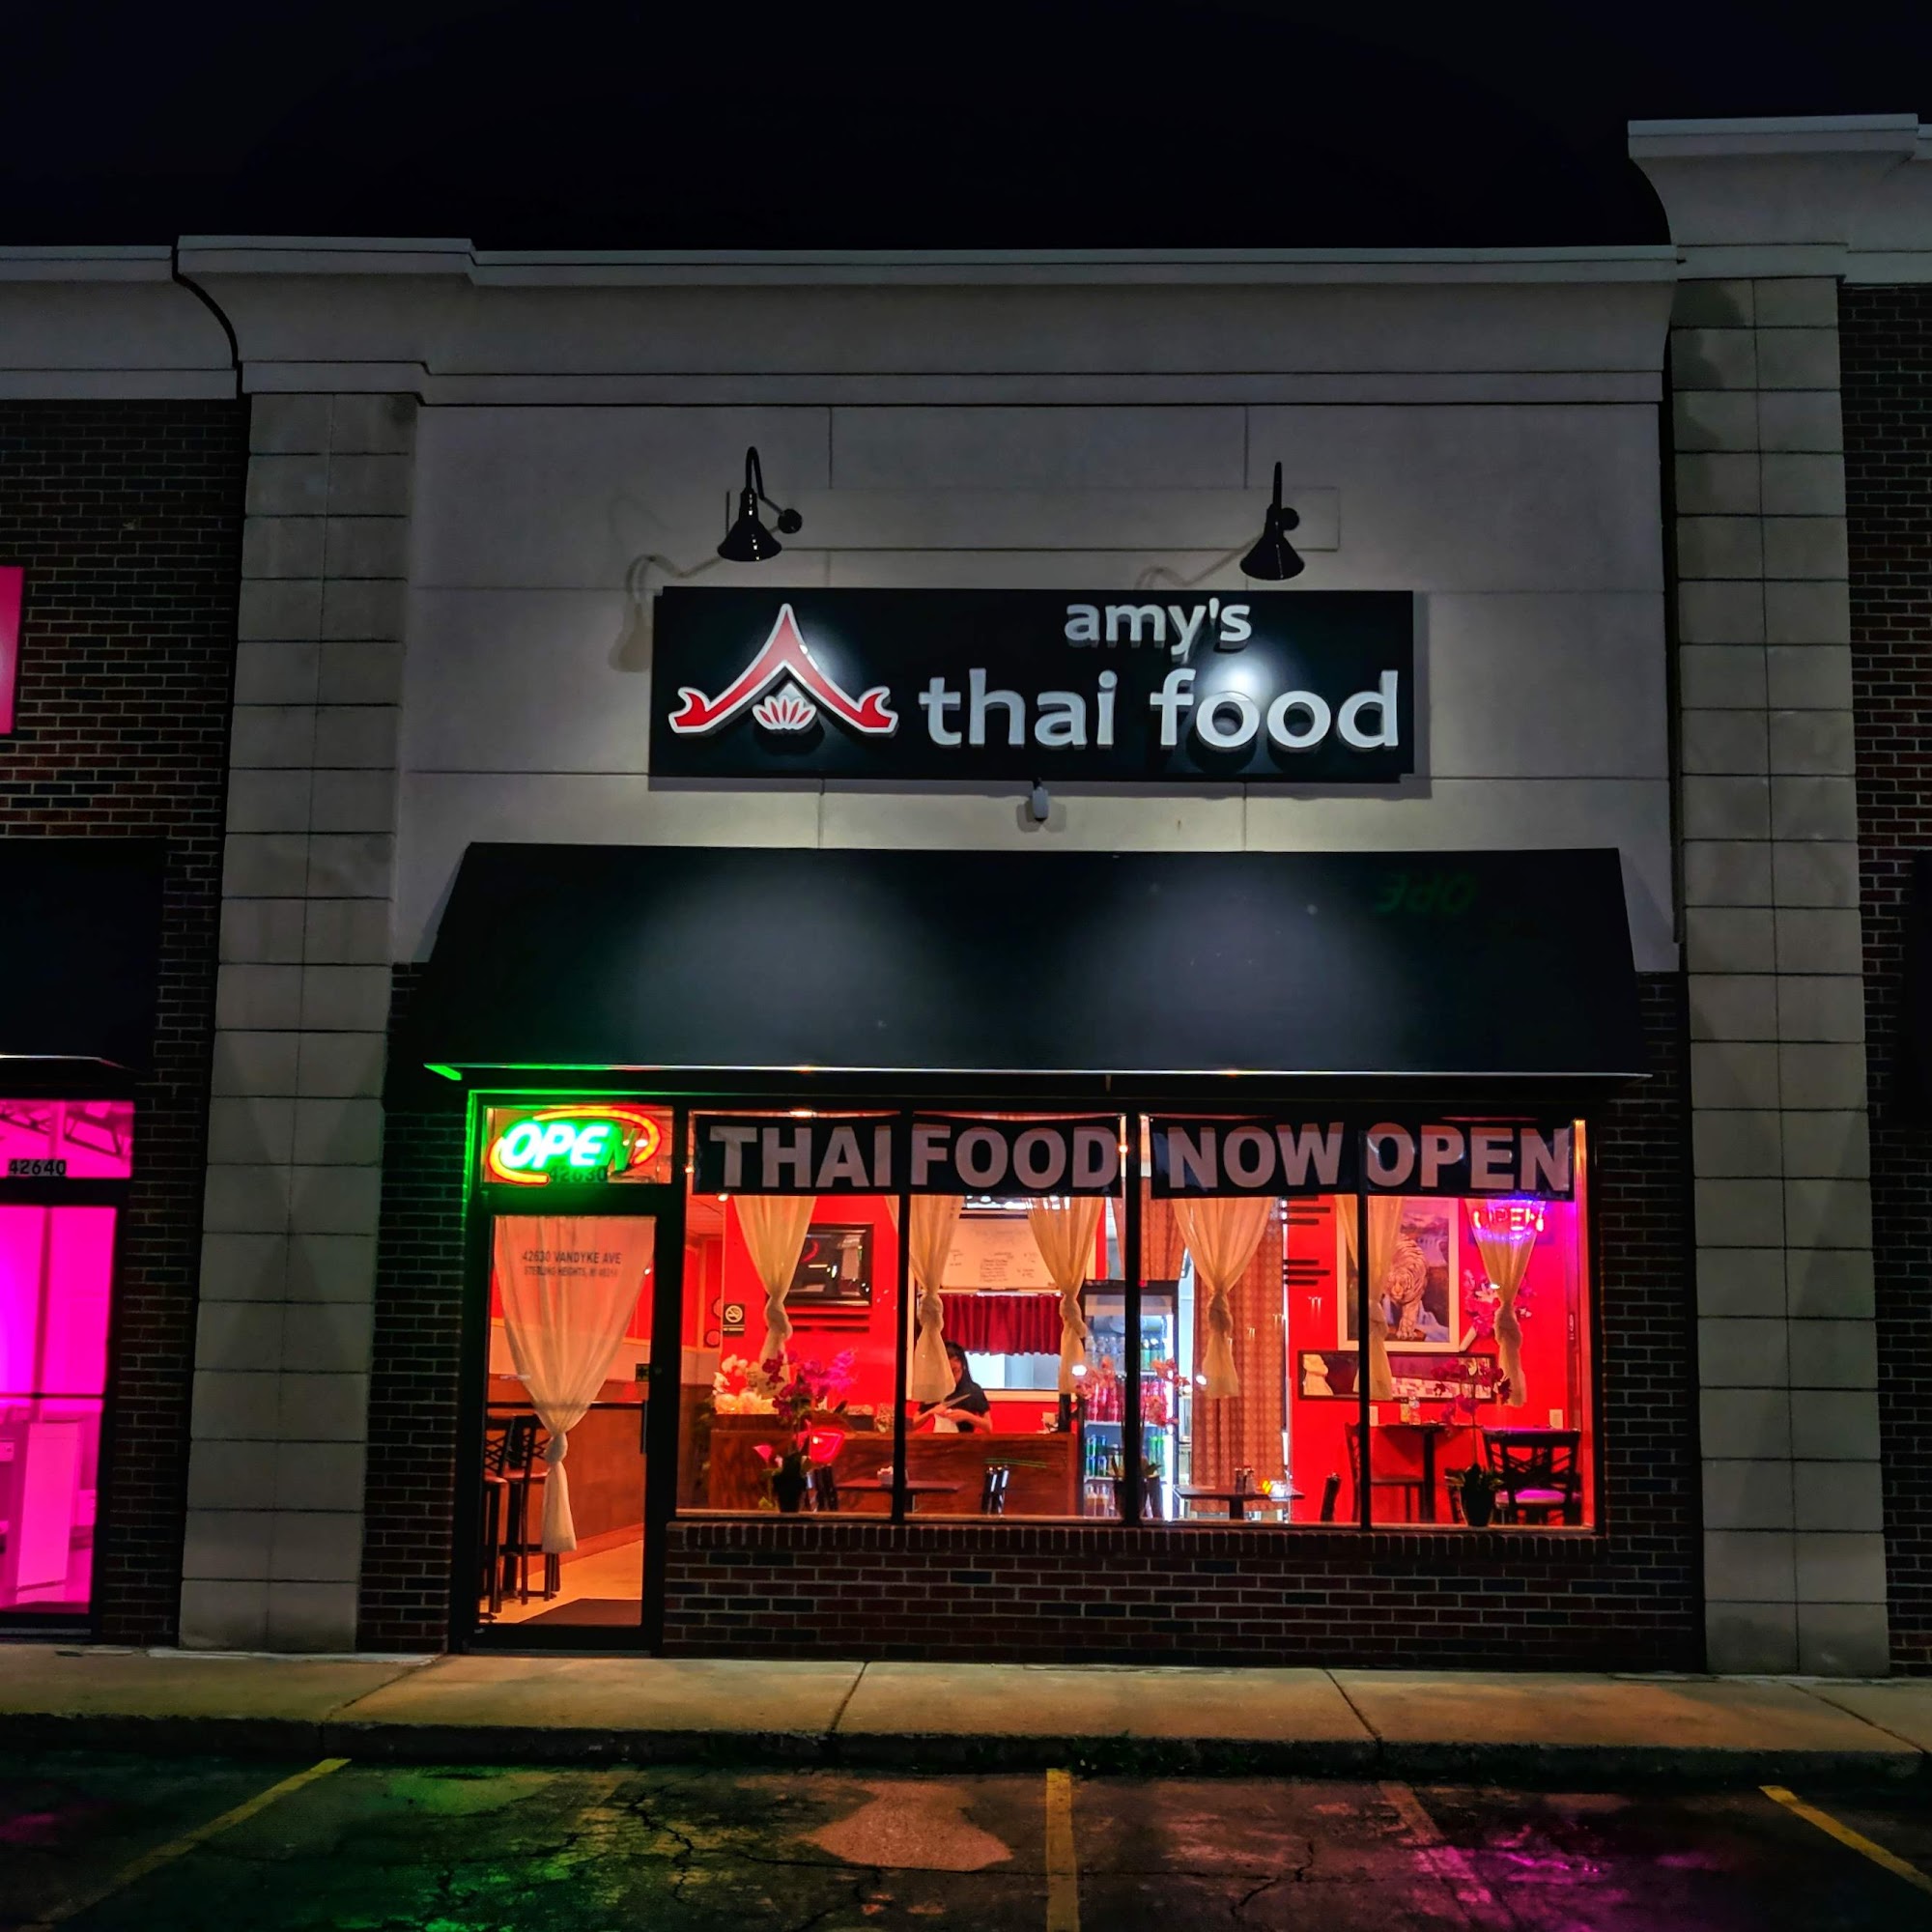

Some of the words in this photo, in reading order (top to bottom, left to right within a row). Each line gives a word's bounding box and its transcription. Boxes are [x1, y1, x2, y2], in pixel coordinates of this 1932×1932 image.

[1064, 597, 1252, 663] amy's
[918, 668, 1118, 748] thai
[1149, 668, 1399, 750] food
[9, 1159, 67, 1176] 42640
[709, 1124, 893, 1188] THAI
[910, 1122, 1119, 1189] FOOD
[1166, 1122, 1345, 1189] NOW
[1366, 1122, 1574, 1192] OPEN
[603, 1252, 621, 1264] AVE
